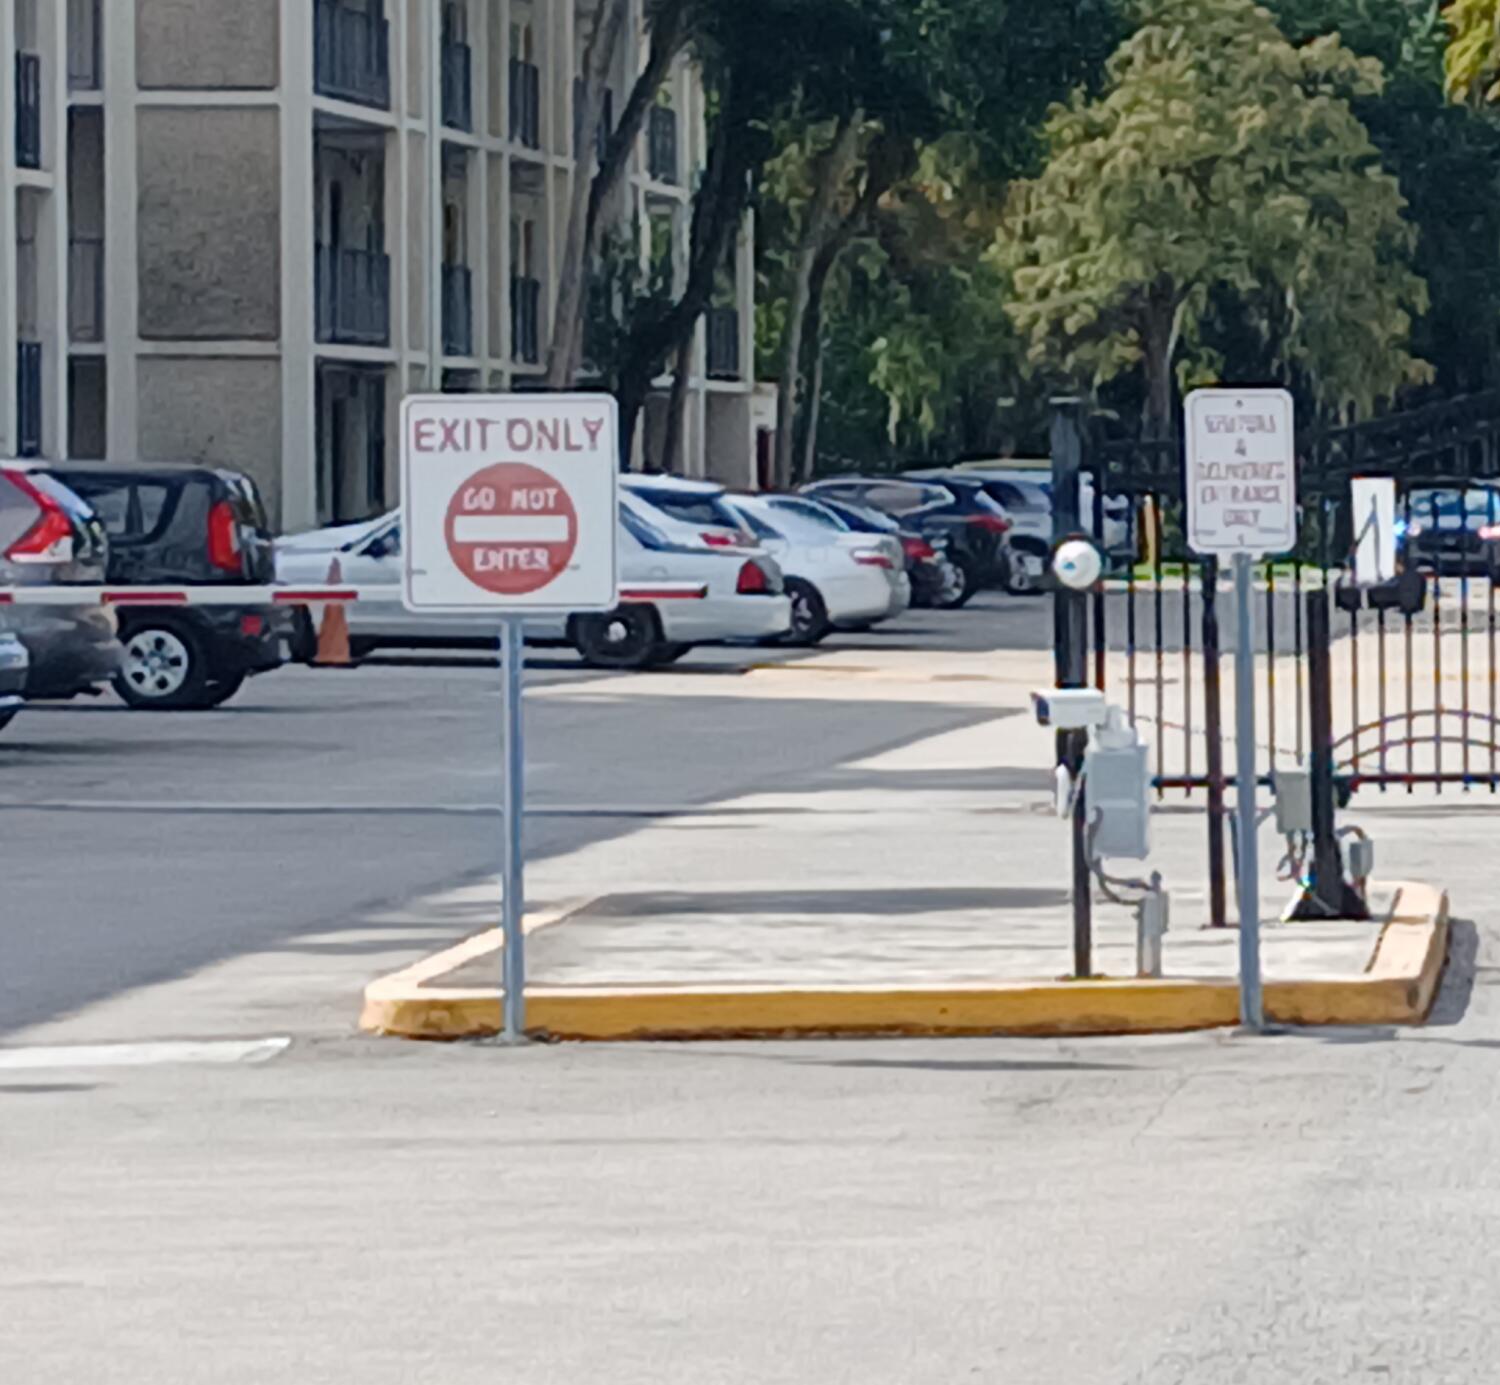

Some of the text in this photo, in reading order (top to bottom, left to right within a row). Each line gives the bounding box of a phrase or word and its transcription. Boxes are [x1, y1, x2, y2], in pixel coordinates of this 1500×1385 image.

[414, 417, 604, 452] EXIT ONLY
[511, 487, 558, 510] NOT
[473, 547, 549, 572] ENTER
